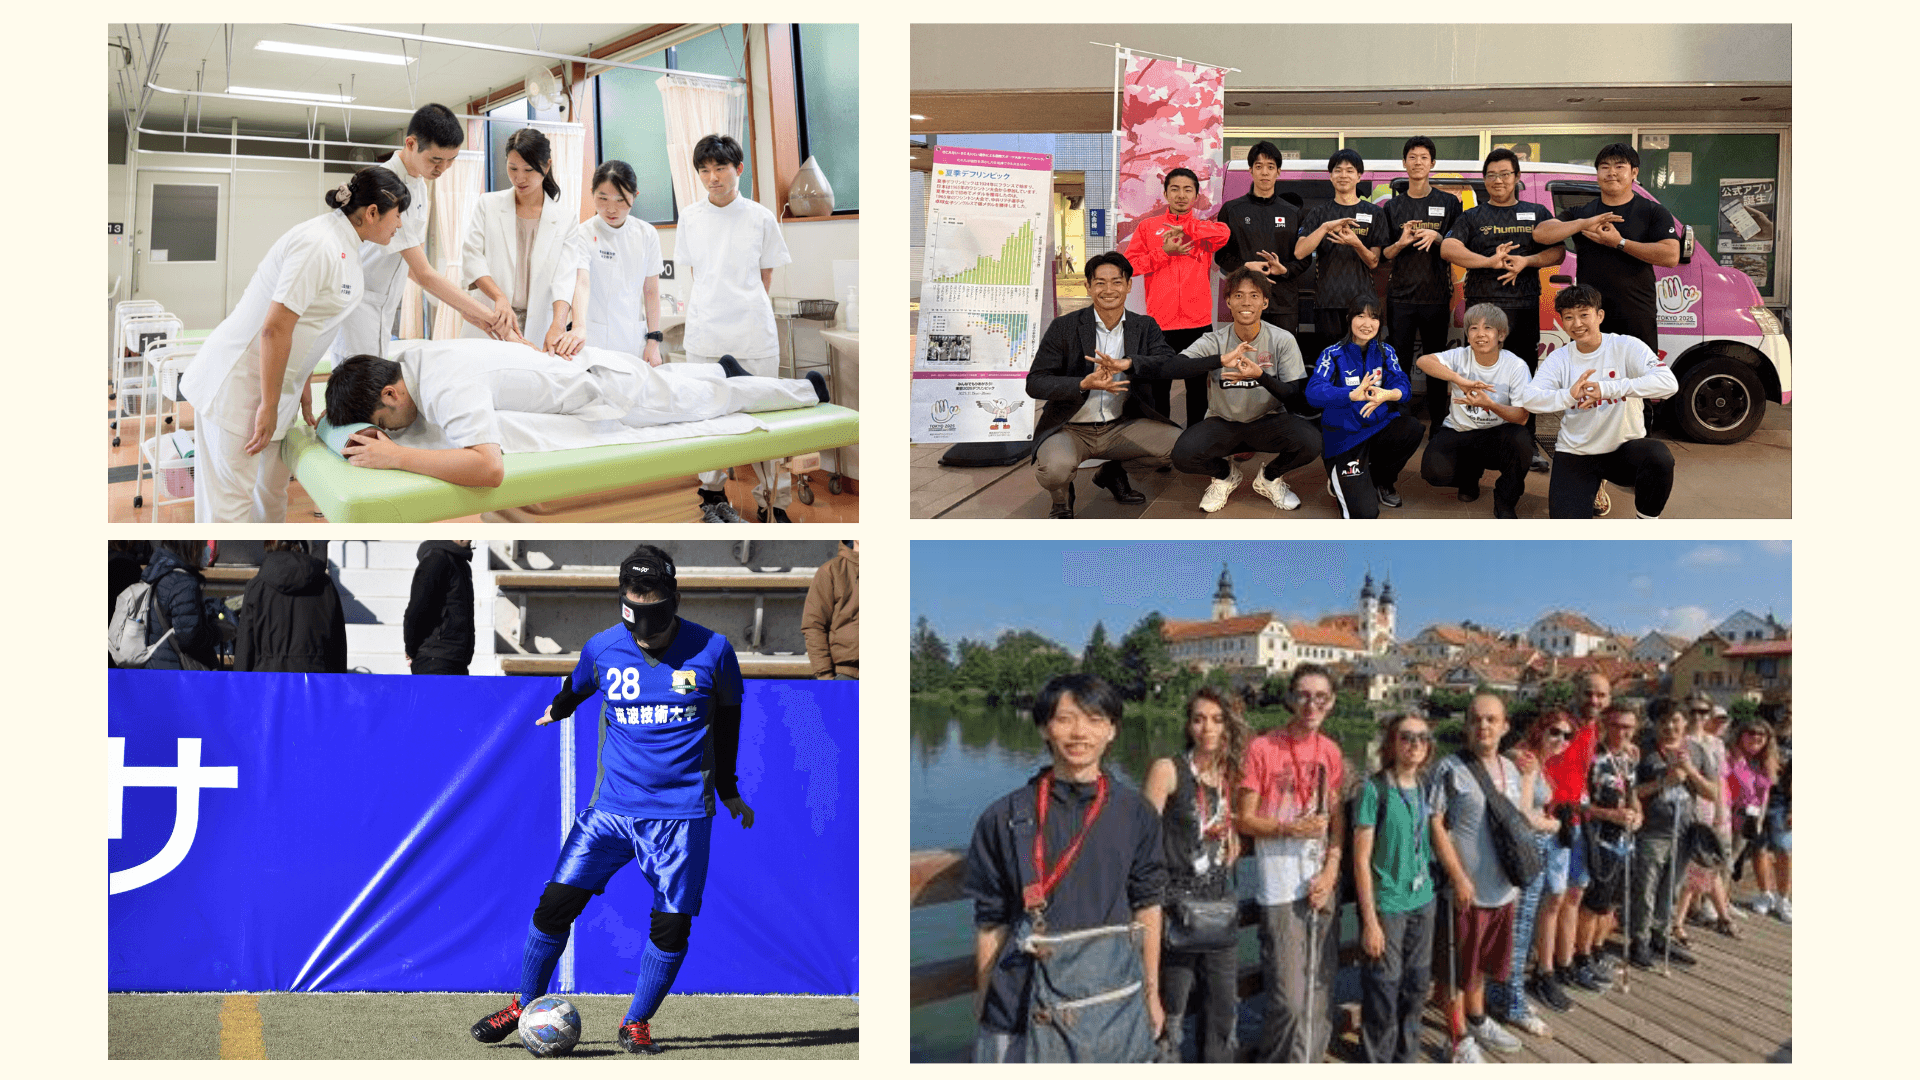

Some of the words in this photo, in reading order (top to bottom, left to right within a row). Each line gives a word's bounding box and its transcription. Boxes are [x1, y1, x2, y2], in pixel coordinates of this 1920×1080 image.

[945, 169, 1010, 179] 夏季デフリンピック
[1721, 184, 1773, 197] 公式アプリ
[108, 224, 121, 233] 13
[1493, 225, 1534, 234] hummel
[606, 667, 640, 700] 28
[108, 737, 238, 895] サ
